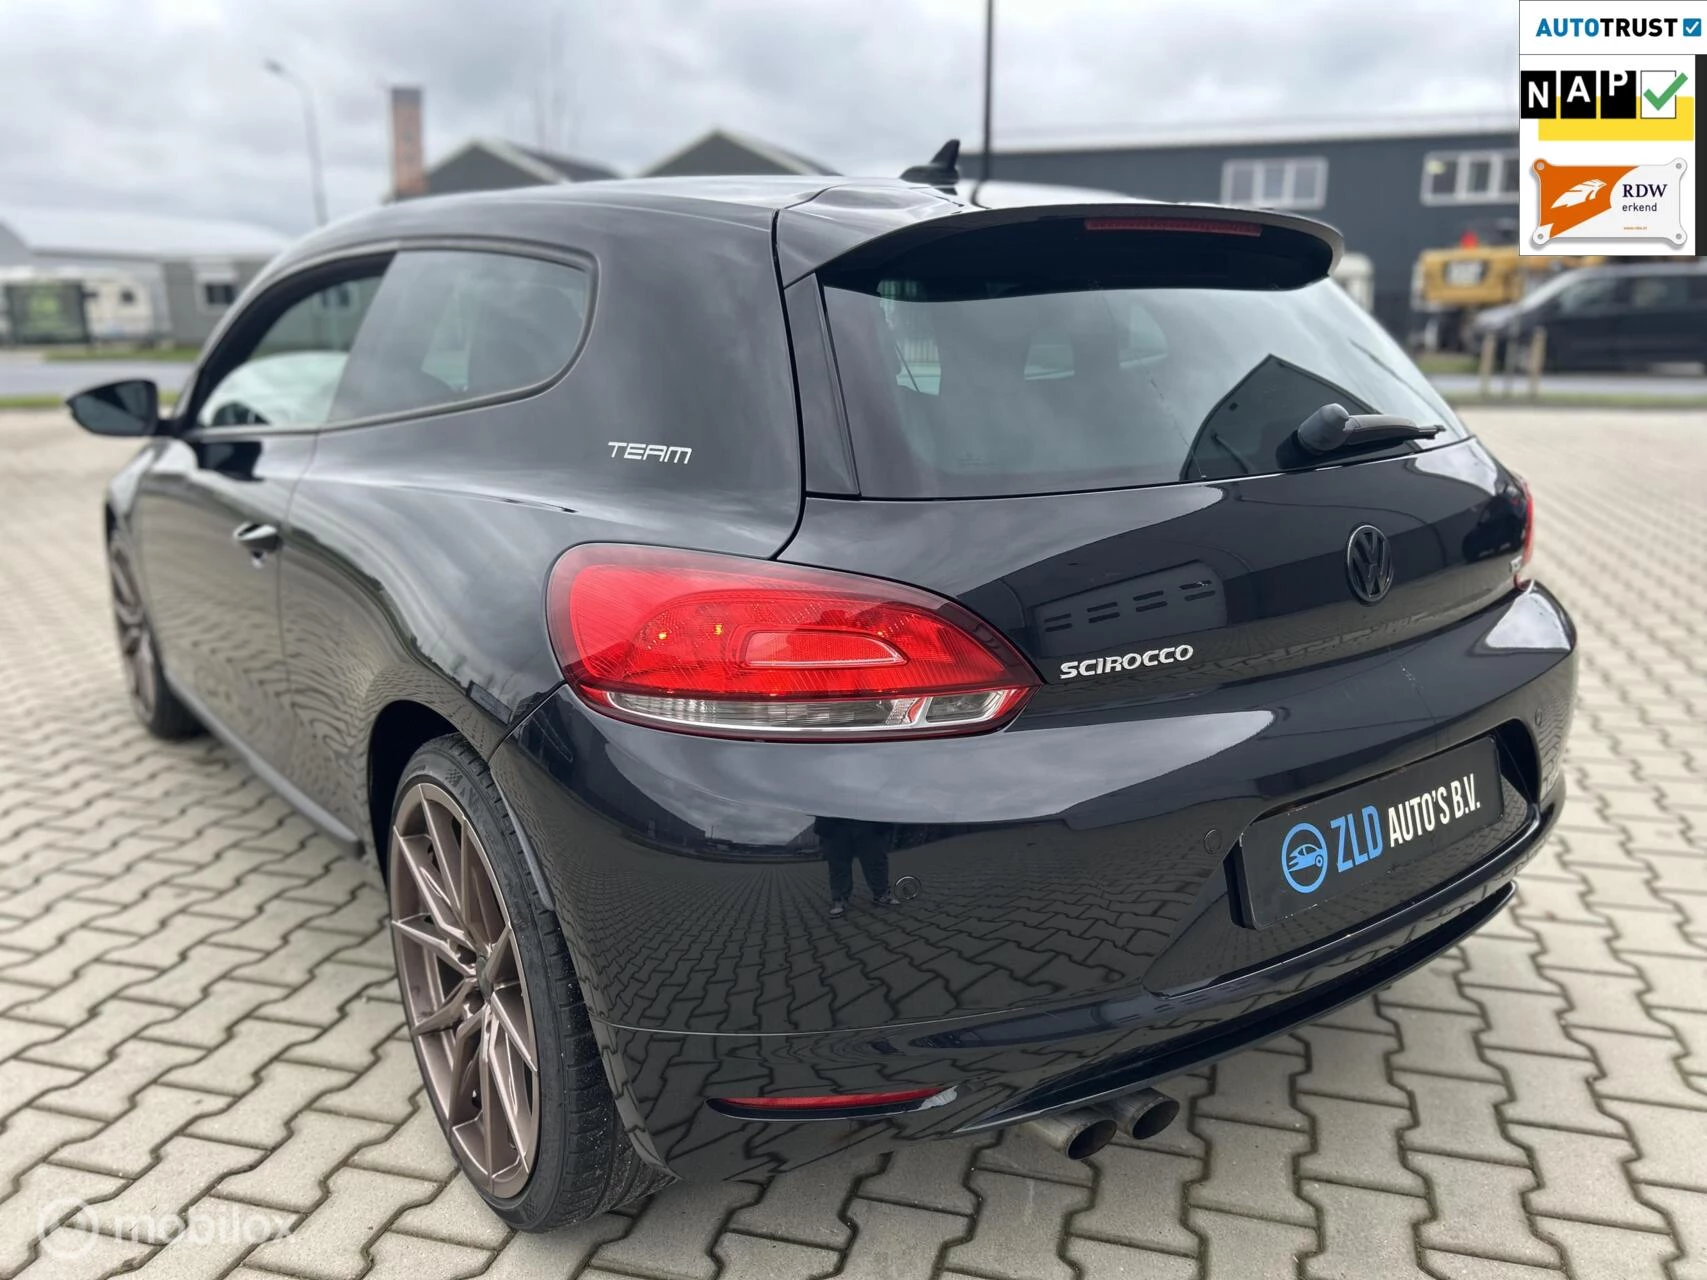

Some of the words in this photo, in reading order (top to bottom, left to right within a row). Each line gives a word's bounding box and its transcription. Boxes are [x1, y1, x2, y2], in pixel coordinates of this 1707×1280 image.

[607, 441, 693, 465] TEAM
[1060, 644, 1194, 679] SCIROCCO
[1330, 805, 1384, 873] ZLD
[1387, 786, 1450, 848] AUTO'S
[1450, 773, 1481, 819] B.V.
